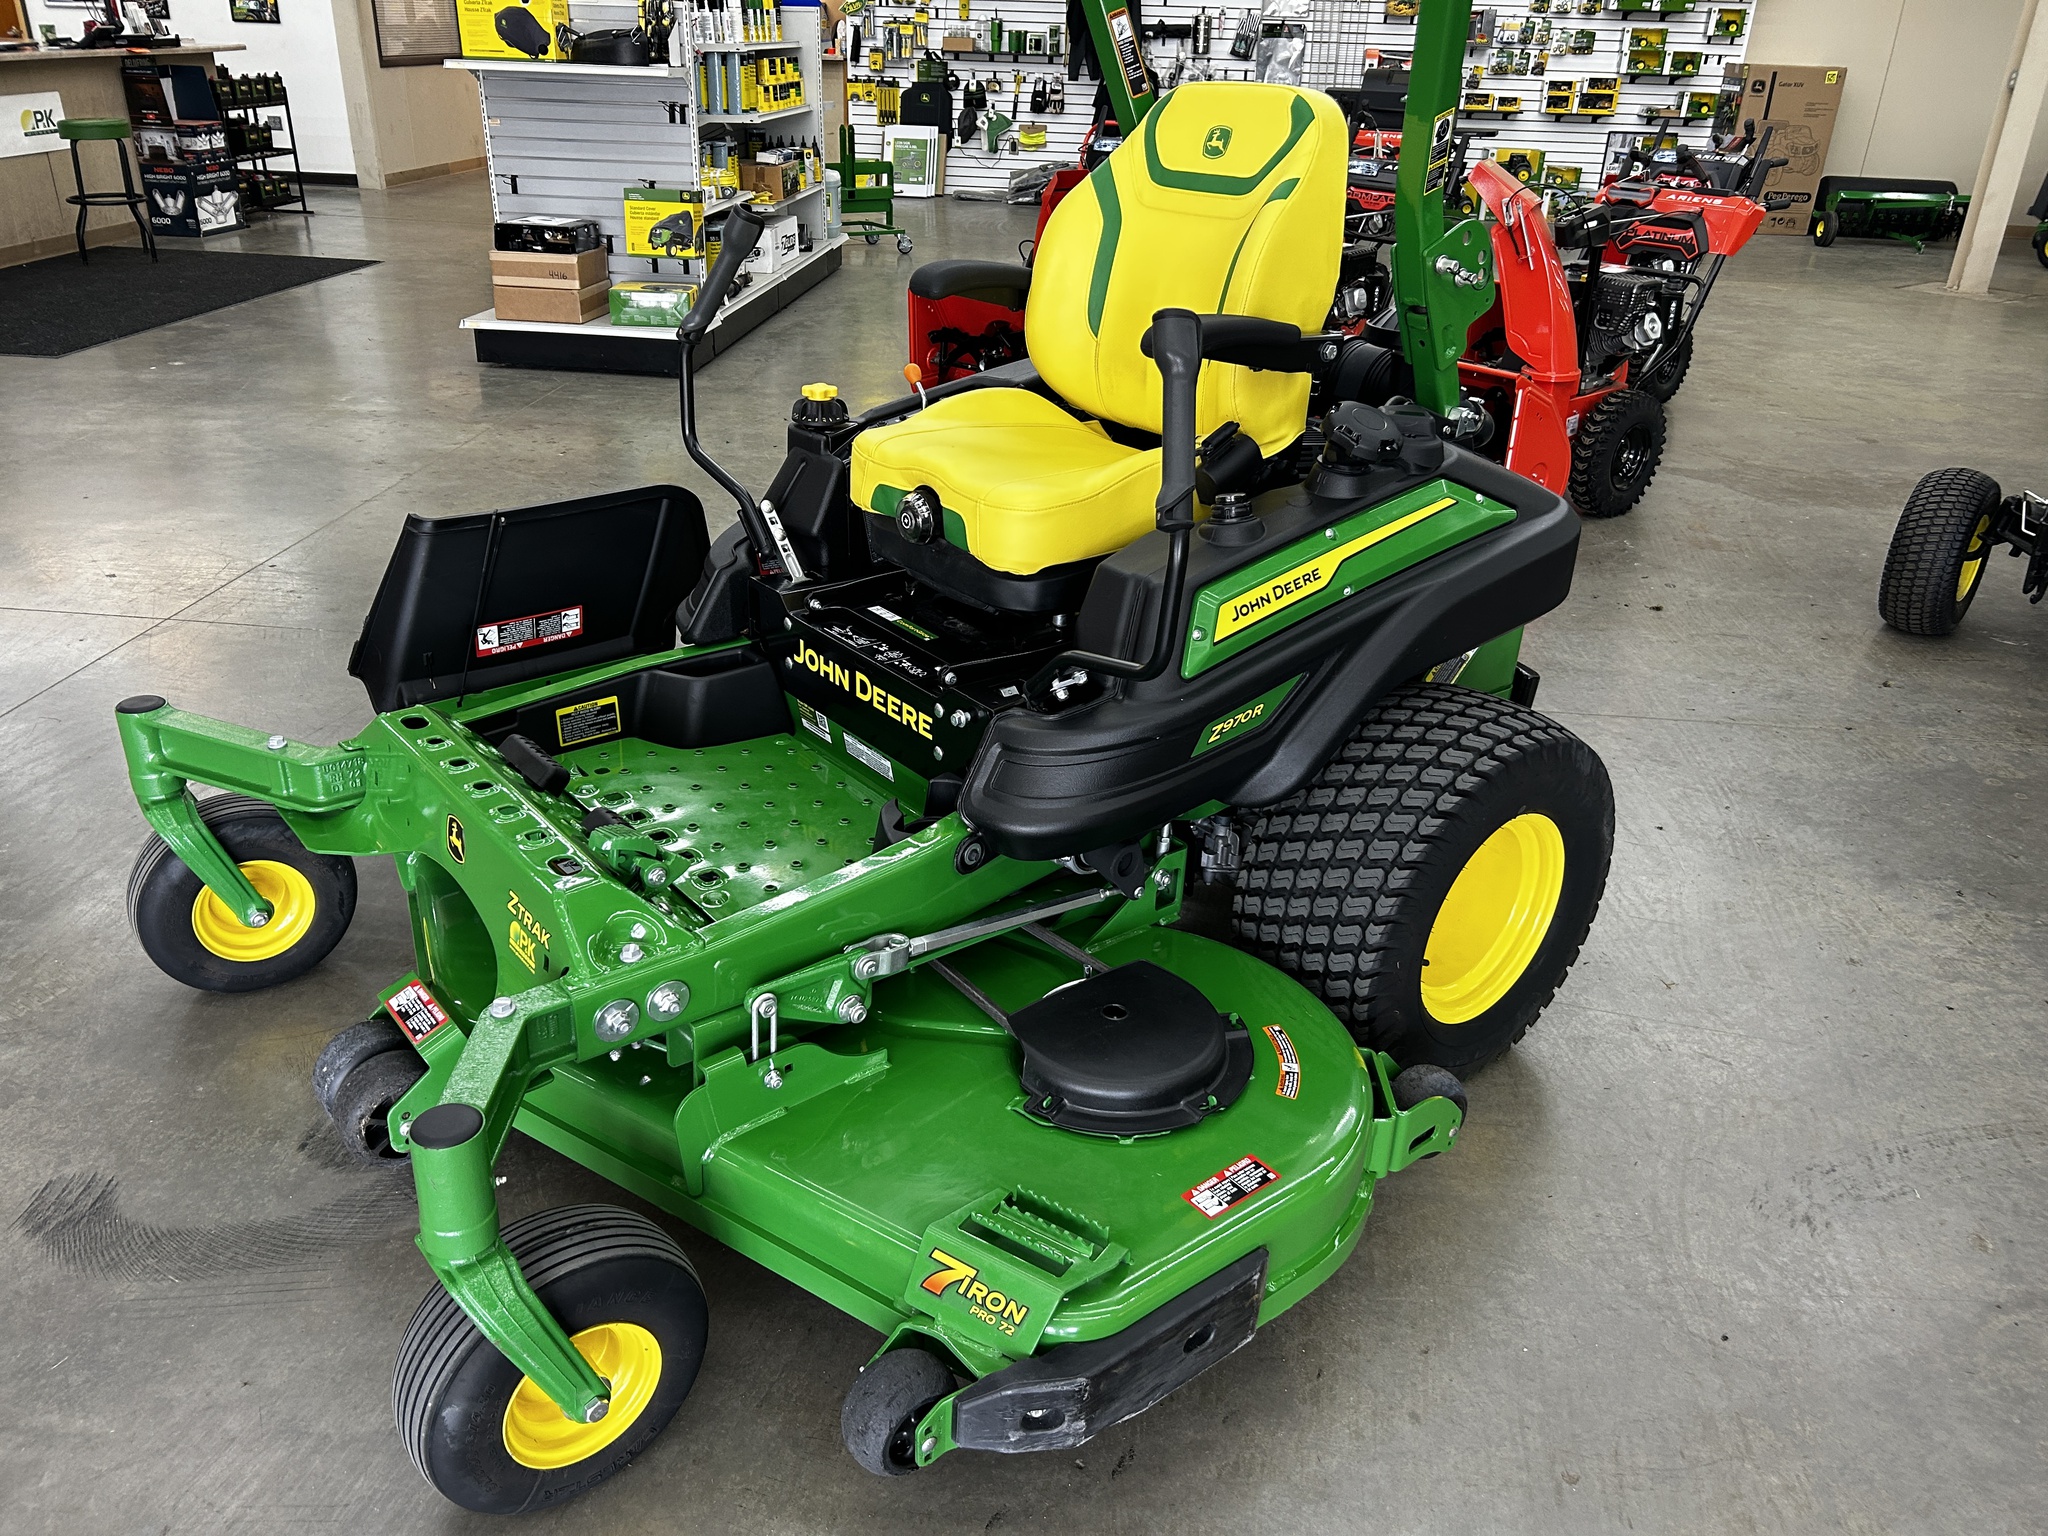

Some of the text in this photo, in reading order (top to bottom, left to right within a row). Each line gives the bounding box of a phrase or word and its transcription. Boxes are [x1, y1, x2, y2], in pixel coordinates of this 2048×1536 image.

[1694, 153, 1739, 162] ARIENS
[206, 171, 220, 179] BRIGHT
[1666, 194, 1723, 205] ARIENS
[152, 217, 171, 225] 6000
[1626, 228, 1694, 245] PLATINUM
[548, 270, 568, 280] 4416
[1232, 568, 1322, 622] JOHN DEERE
[543, 633, 566, 643] DANGER
[491, 644, 516, 654] PELIGRO
[793, 638, 850, 692] JOHN
[856, 670, 933, 741] DEERE
[577, 702, 598, 710] CAUTION
[1207, 703, 1265, 744] Z970R
[507, 888, 552, 950] ZTRAK
[1228, 1157, 1252, 1173] PELIGRO
[1196, 1176, 1220, 1191] DANGER
[969, 1305, 1016, 1336] PRO 72
